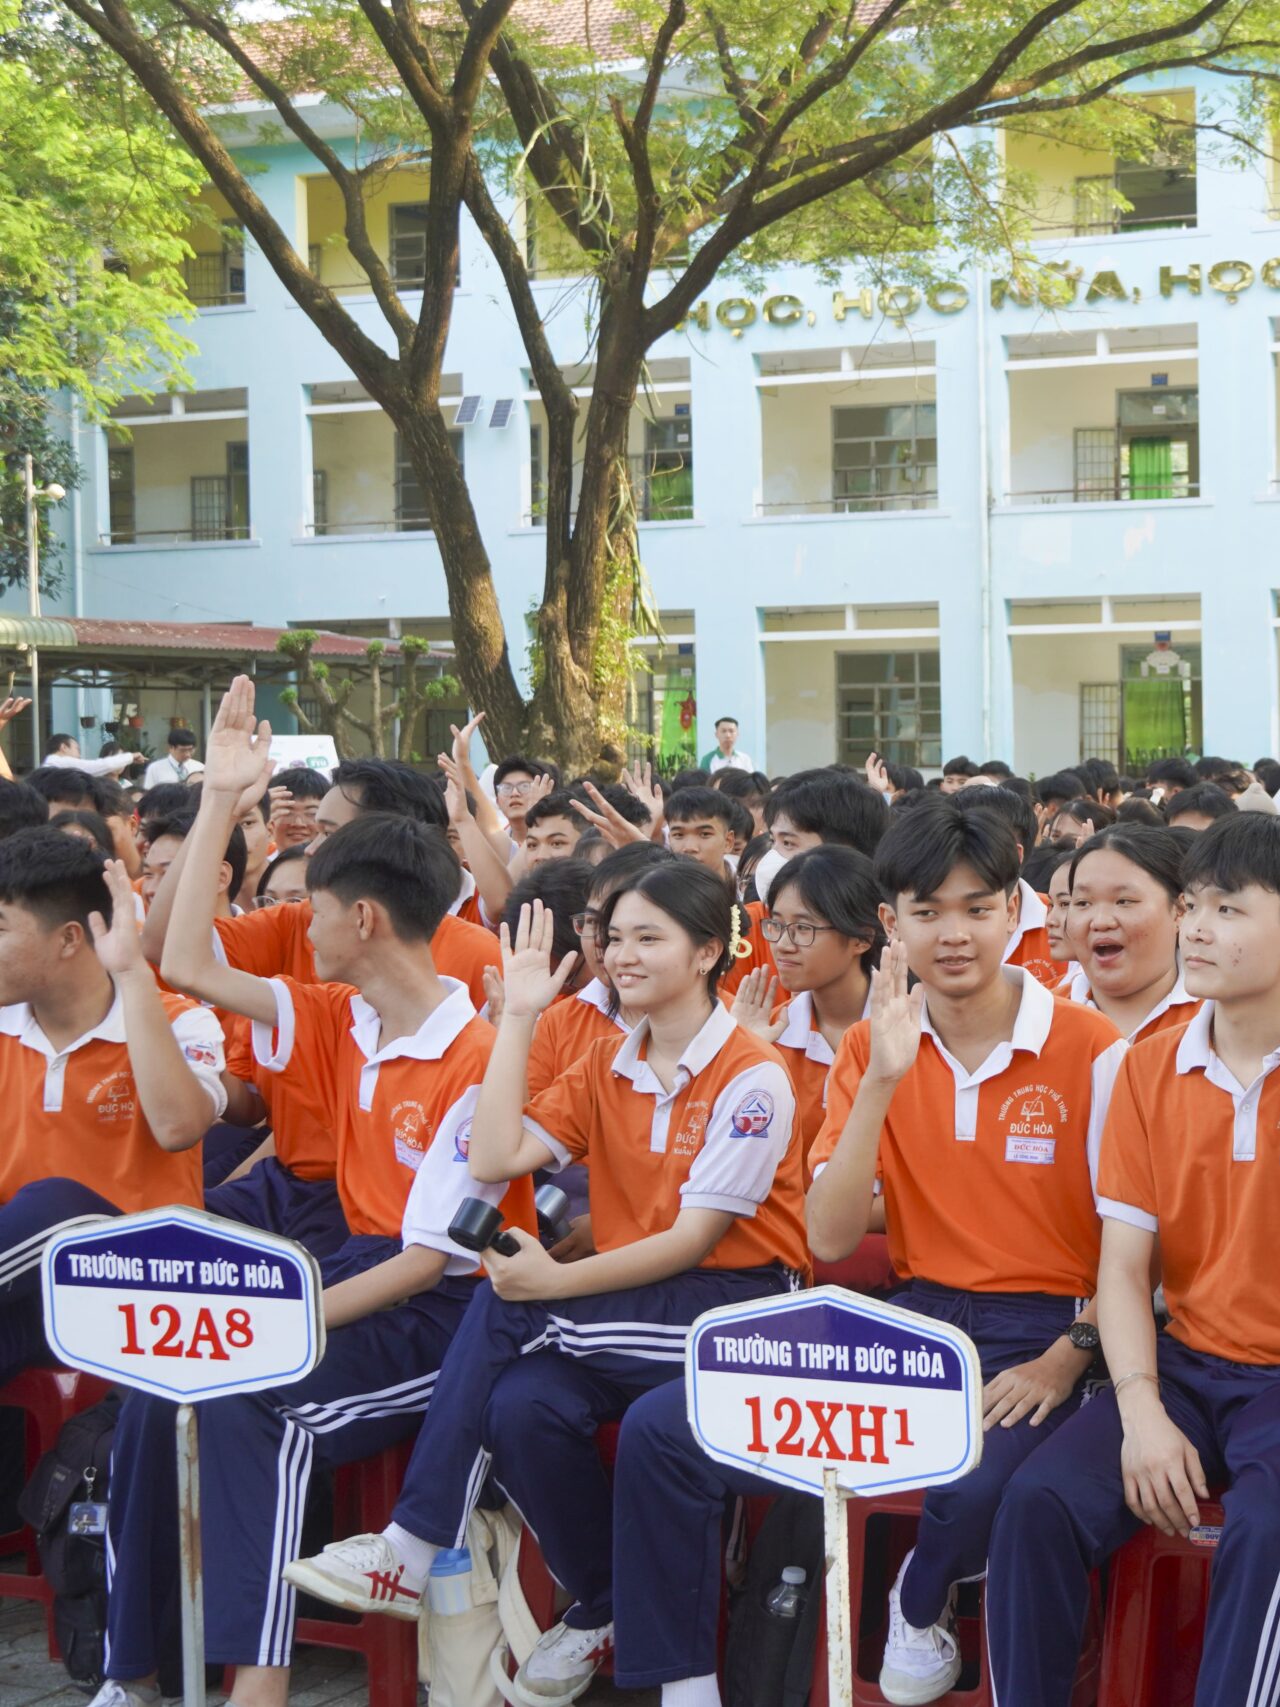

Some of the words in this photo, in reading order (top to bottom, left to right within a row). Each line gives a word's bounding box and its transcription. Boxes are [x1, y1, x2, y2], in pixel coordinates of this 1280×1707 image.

[832, 281, 970, 329] HỌC
[1013, 1084, 1034, 1098] TRUNG
[1009, 1120, 1031, 1134] ĐỨC
[1033, 1121, 1054, 1135] HÒA
[68, 1250, 144, 1281] TRƯỜNG
[148, 1258, 195, 1284] THPT
[199, 1257, 240, 1287] ĐỨC
[244, 1259, 285, 1290] HÒA
[117, 1303, 254, 1361] 12A8
[713, 1332, 793, 1367] TRƯỜNG
[797, 1342, 850, 1371] THPH
[854, 1342, 897, 1375] ĐỨC
[902, 1344, 946, 1379] HÒA
[744, 1395, 915, 1465] 12XH1
